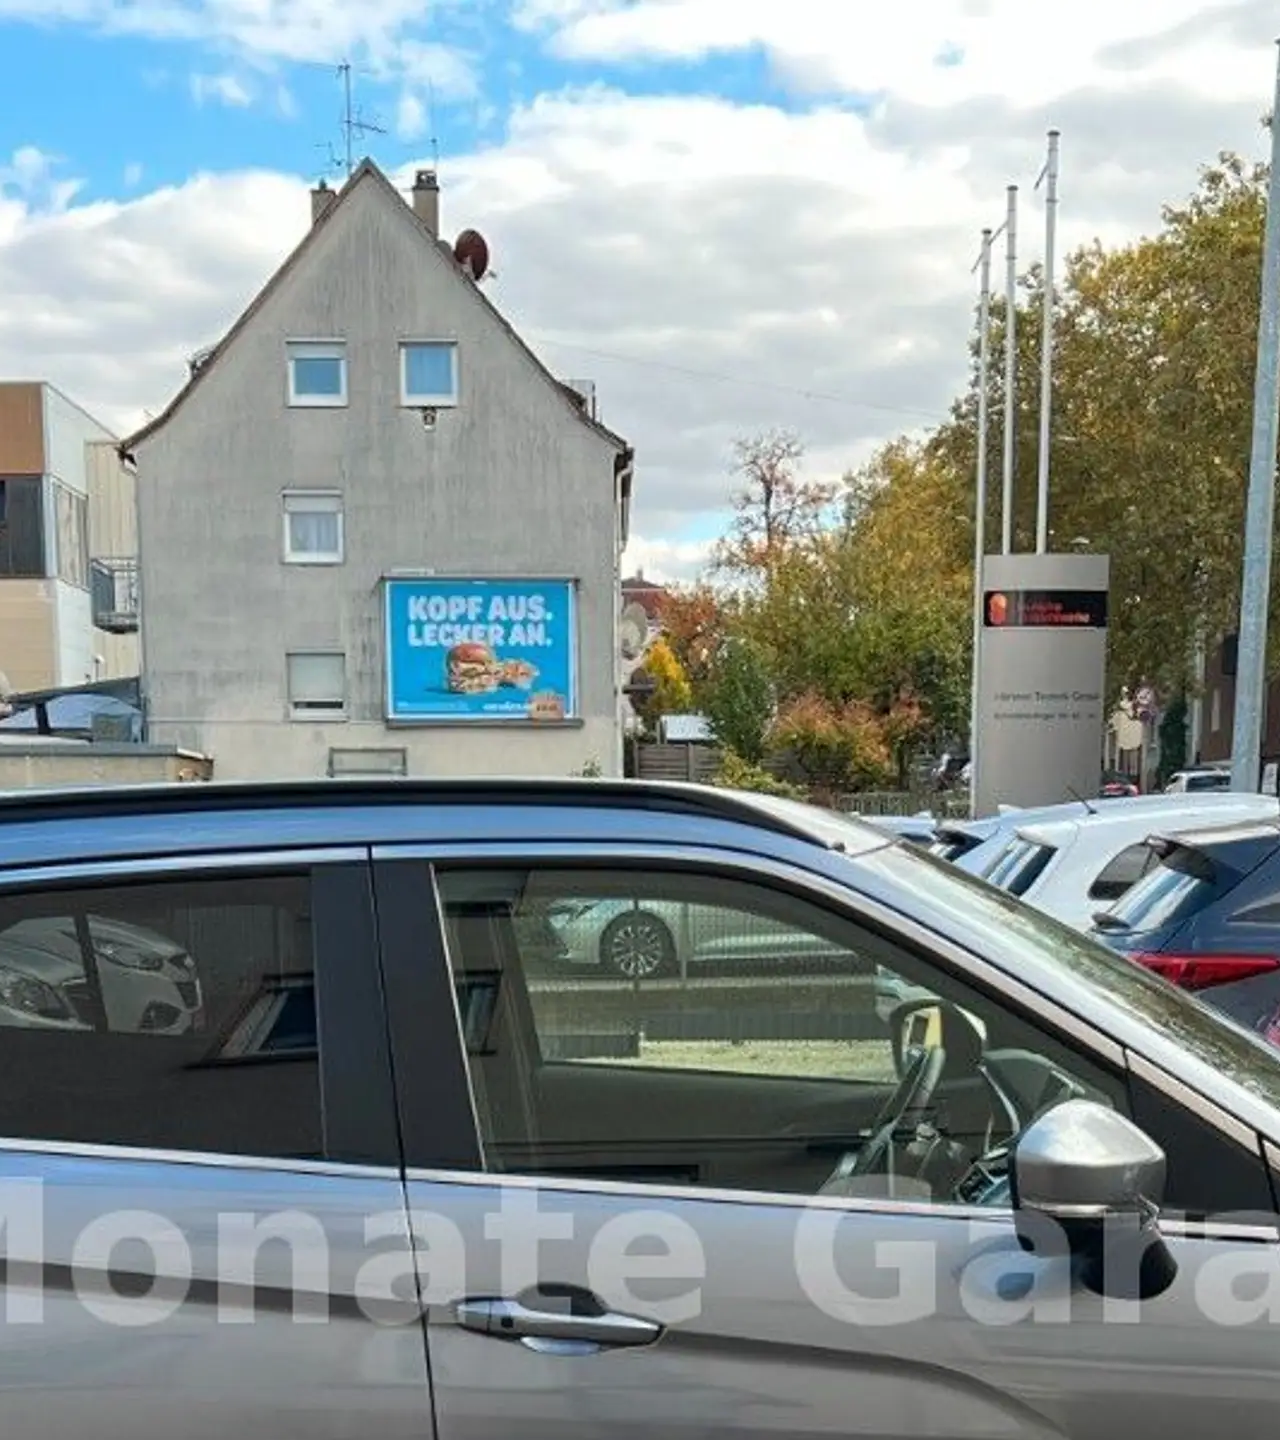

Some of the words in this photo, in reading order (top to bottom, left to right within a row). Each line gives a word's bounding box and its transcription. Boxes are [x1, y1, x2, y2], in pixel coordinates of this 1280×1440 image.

[407, 595, 483, 621] KOPF
[487, 594, 553, 621] AUS.
[407, 623, 504, 647] LECKER
[507, 622, 553, 647] AN.
